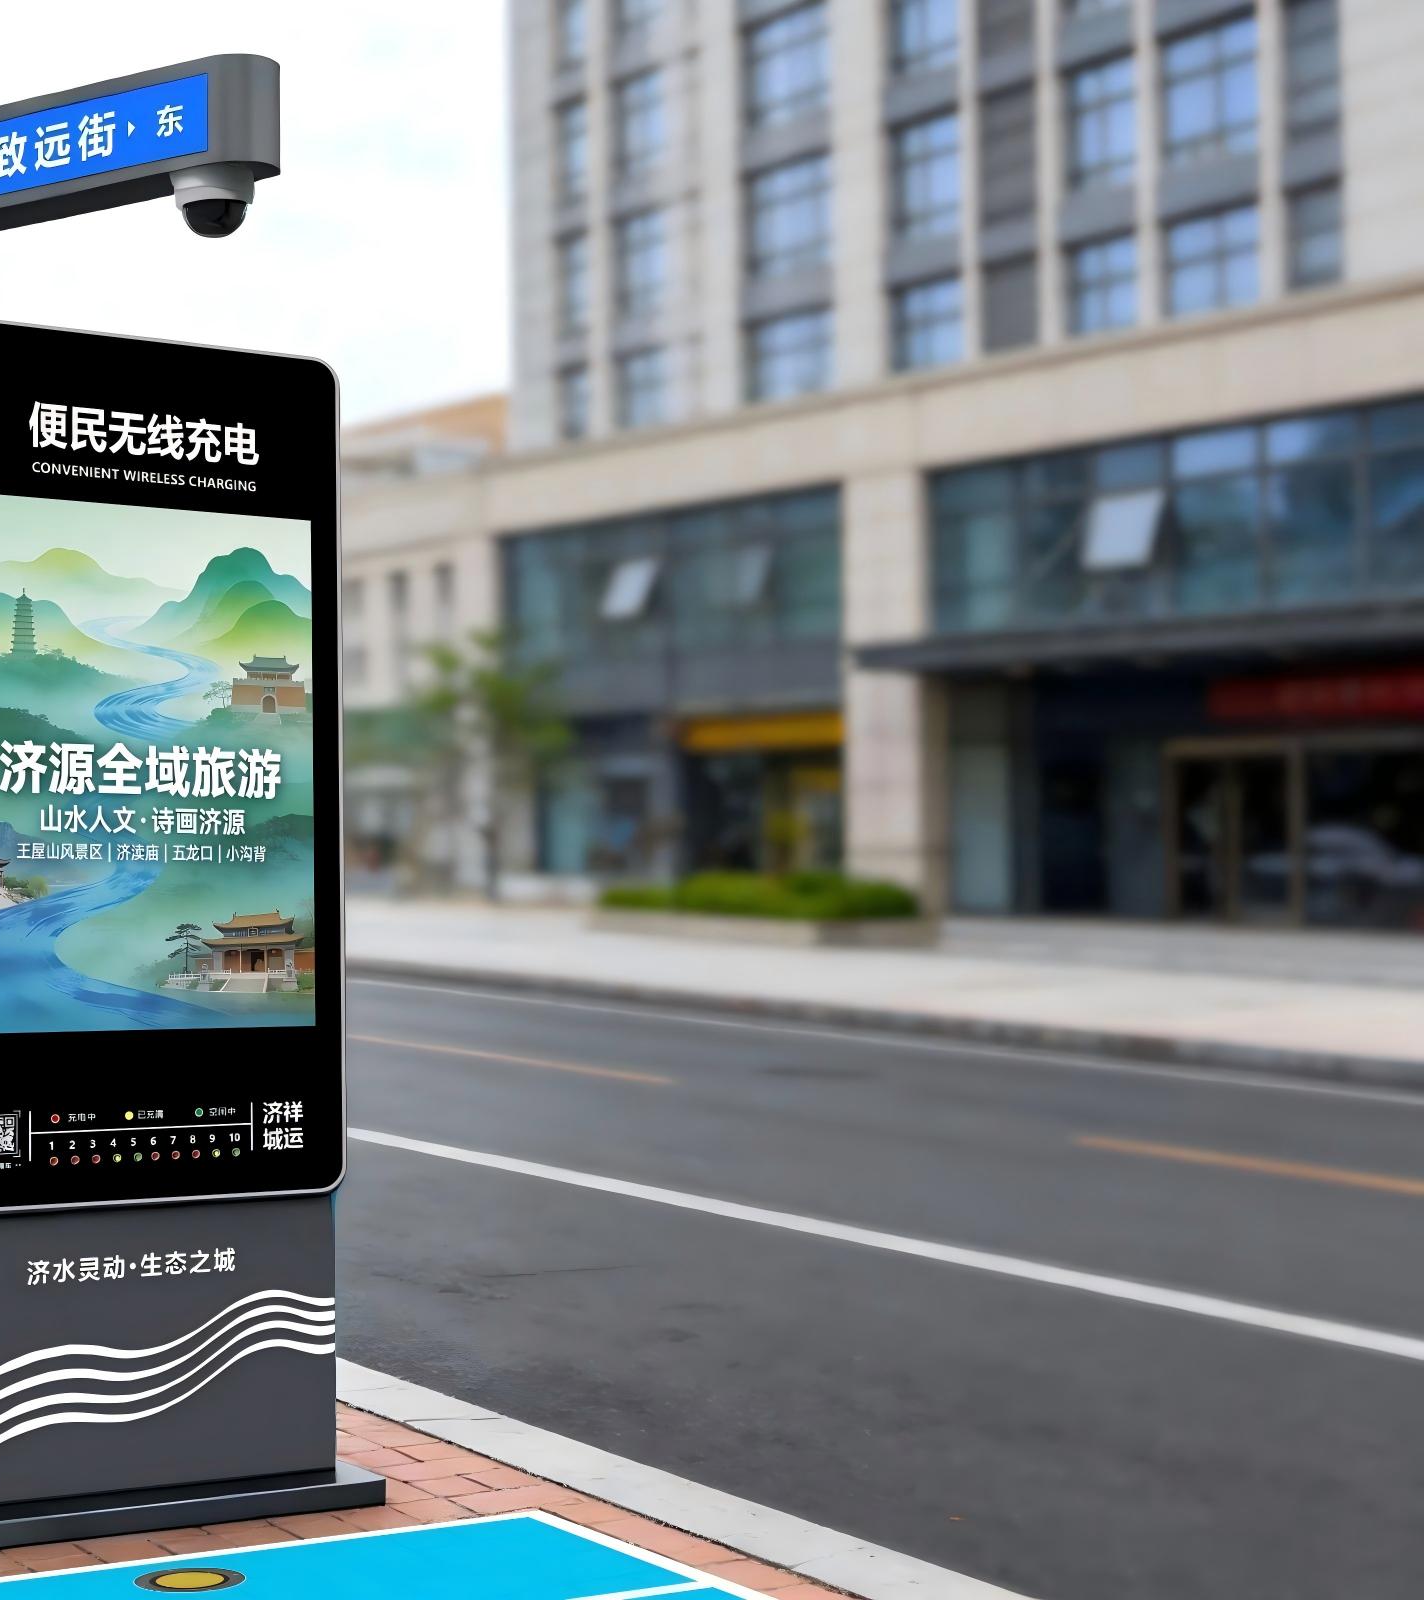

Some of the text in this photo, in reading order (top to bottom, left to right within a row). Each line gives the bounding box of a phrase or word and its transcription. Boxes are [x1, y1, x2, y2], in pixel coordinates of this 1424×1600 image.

[156, 104, 184, 138] 东
[29, 400, 260, 466] 便民无线充电
[31, 461, 257, 493] CONVENIENT WIRELESS CHARGING
[0, 739, 282, 800] 济源全域旅游
[40, 804, 246, 836] 山水人文·诗画济源
[262, 1100, 304, 1125] 济祥
[48, 1132, 241, 1151] 1 2 3 4 5 6 7 8 9 10
[262, 1127, 304, 1151] 城运
[26, 1247, 236, 1286] 济水灵动·生态之城
